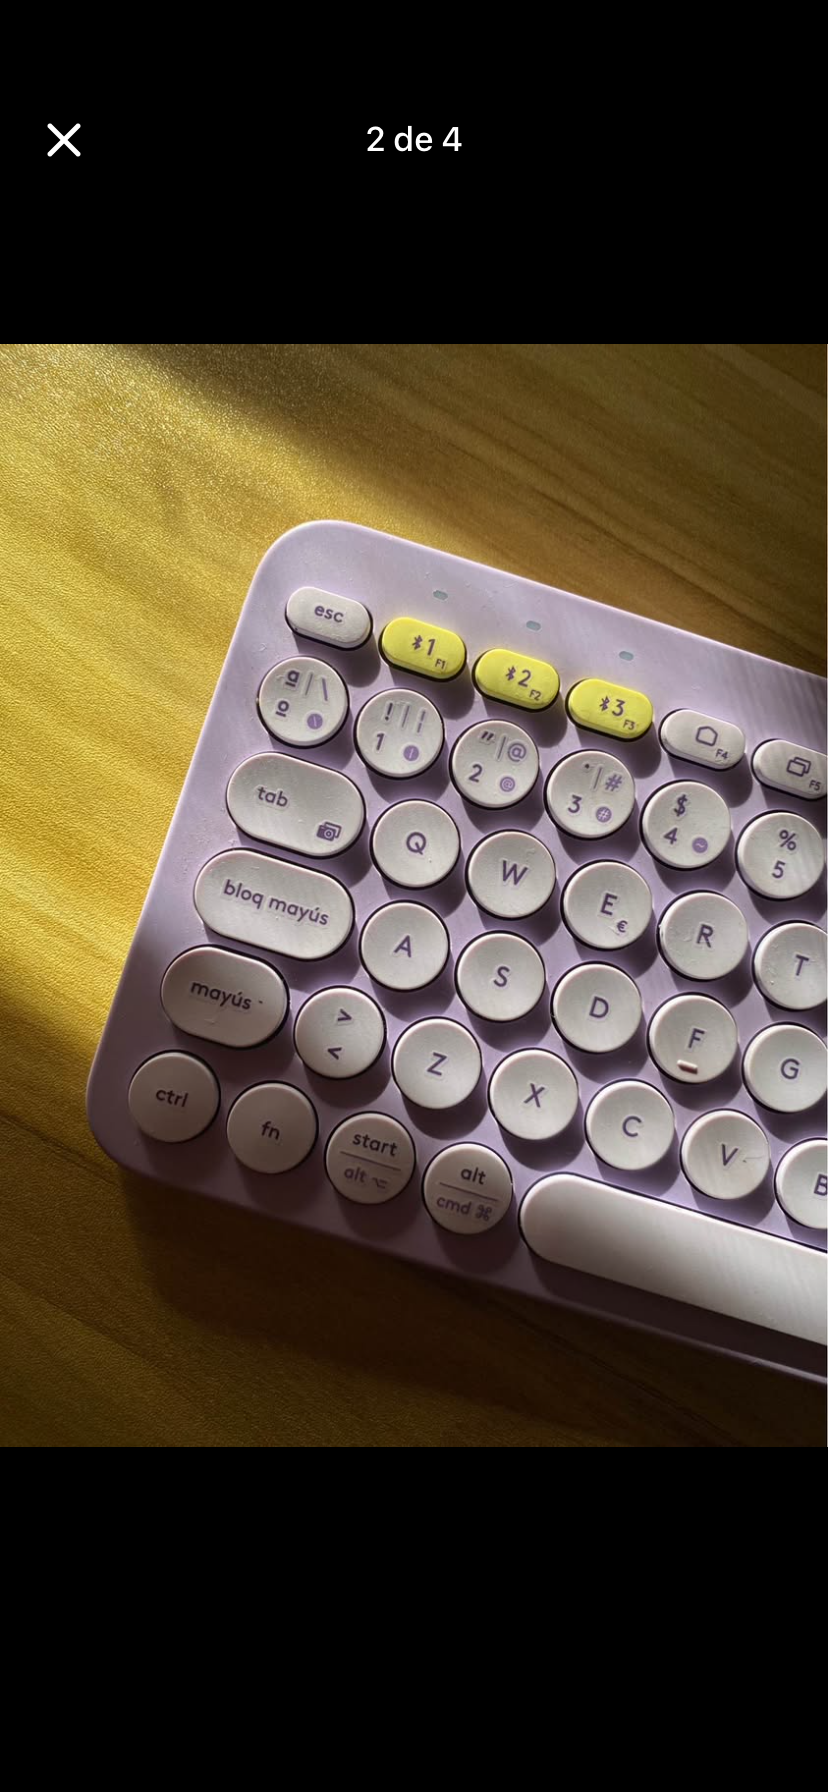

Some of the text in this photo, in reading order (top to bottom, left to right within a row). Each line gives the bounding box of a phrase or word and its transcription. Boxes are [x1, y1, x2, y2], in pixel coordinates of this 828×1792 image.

[314, 605, 344, 623] esc
[427, 638, 436, 656] 1
[434, 658, 446, 670] F1
[518, 669, 532, 687] 2
[529, 689, 542, 702] F2
[612, 698, 626, 717] 3
[622, 719, 636, 731] F3
[376, 733, 385, 751] 1
[507, 743, 527, 762] @
[715, 748, 728, 761] F4
[469, 763, 483, 782] 2
[605, 774, 622, 792] #
[257, 785, 289, 807] tab
[808, 780, 822, 791] F5
[567, 794, 582, 814] 3
[673, 793, 688, 817] $
[406, 831, 427, 855] Q
[664, 827, 678, 845] 4
[779, 829, 797, 851] %
[502, 860, 528, 885] W
[772, 860, 786, 879] 5
[223, 878, 330, 926] bloq mayús
[600, 893, 617, 916] E
[616, 919, 629, 934] €
[696, 923, 714, 948] R
[393, 934, 412, 958] A
[493, 965, 511, 987] S
[795, 954, 809, 977] T
[190, 980, 253, 1011] mayús
[589, 996, 609, 1019] D
[688, 1027, 705, 1049] F
[426, 1051, 448, 1076] Z
[780, 1058, 800, 1080] G
[154, 1084, 190, 1109] ctrl
[523, 1082, 545, 1108] X
[261, 1120, 281, 1141] fn
[622, 1115, 642, 1138] C
[351, 1132, 399, 1158] start
[721, 1143, 739, 1167] V
[343, 1166, 368, 1184] alt
[460, 1166, 487, 1185] alt
[436, 1196, 473, 1215] cmd
